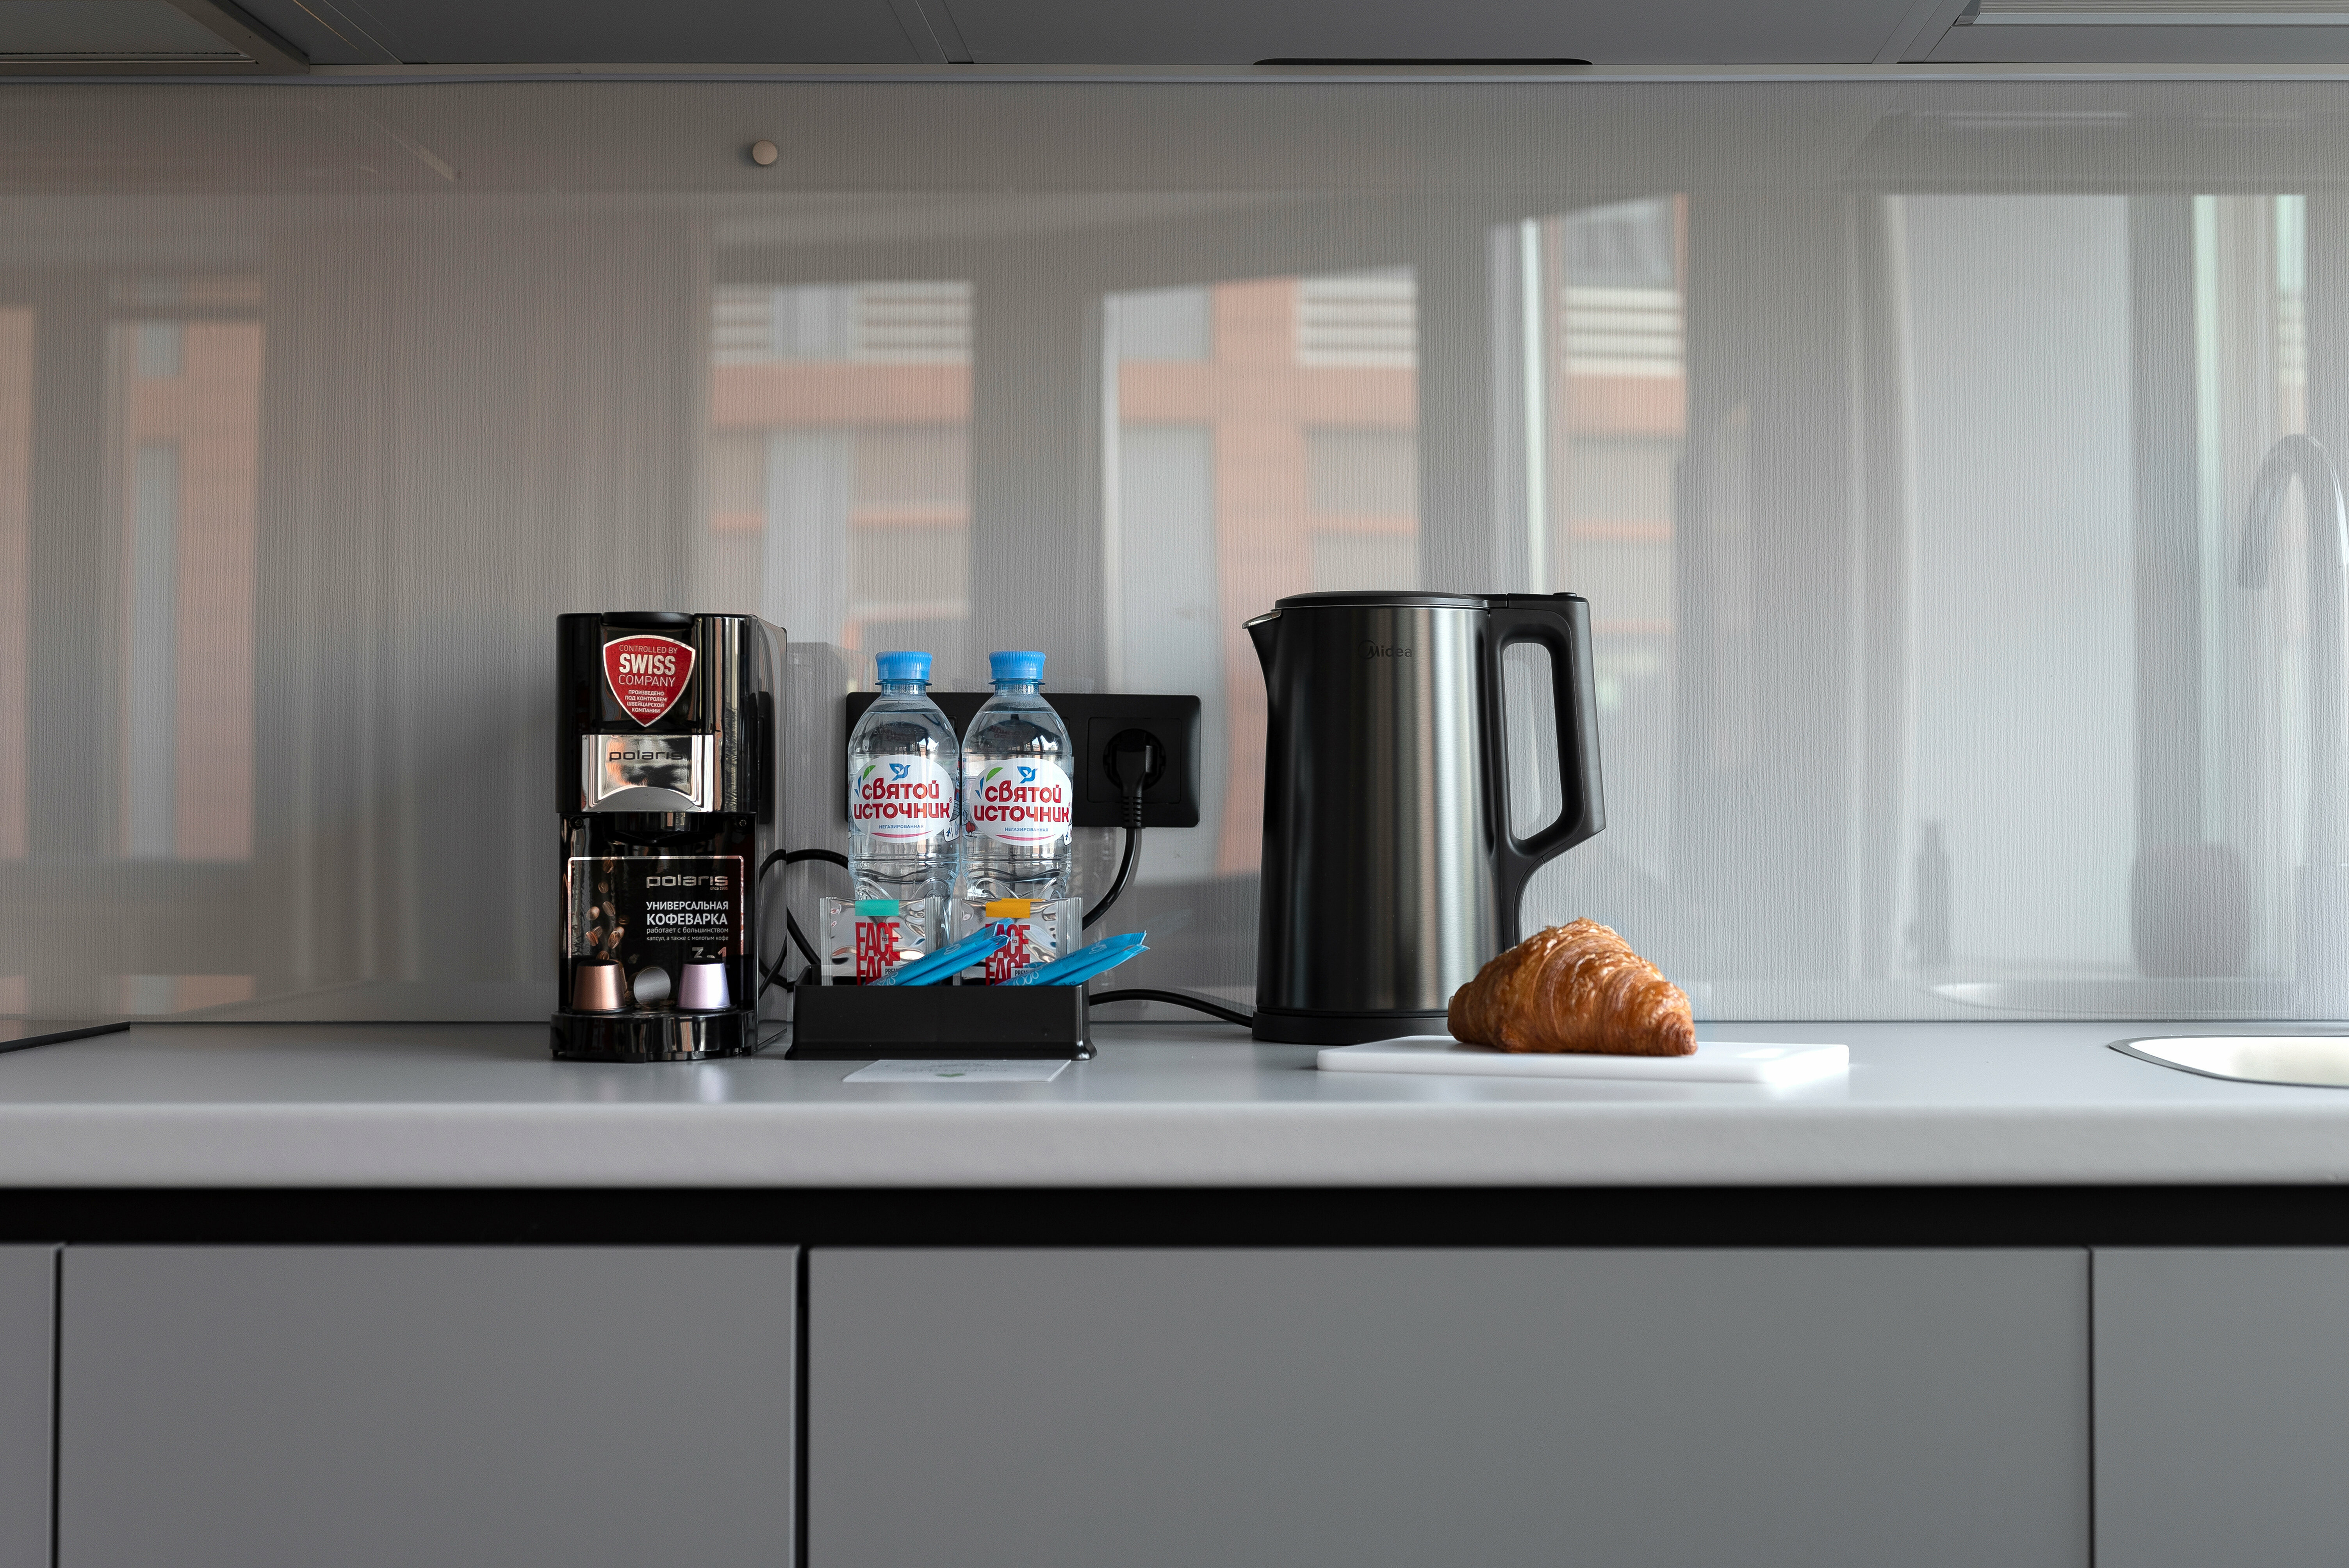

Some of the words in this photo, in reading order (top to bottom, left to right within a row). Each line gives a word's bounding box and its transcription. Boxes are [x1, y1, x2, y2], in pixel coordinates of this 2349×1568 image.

[619, 645, 666, 653] CONTROLLED
[619, 653, 675, 675] SWISS
[618, 674, 675, 687] COMPANY
[610, 750, 683, 761] polaris
[647, 874, 728, 888] polaris
[646, 901, 728, 910] УНИВЕРСАЛЬНАЯ
[647, 913, 728, 925] КОФЕВАРКА
[647, 927, 676, 935] работает
[855, 922, 900, 961] FACE
